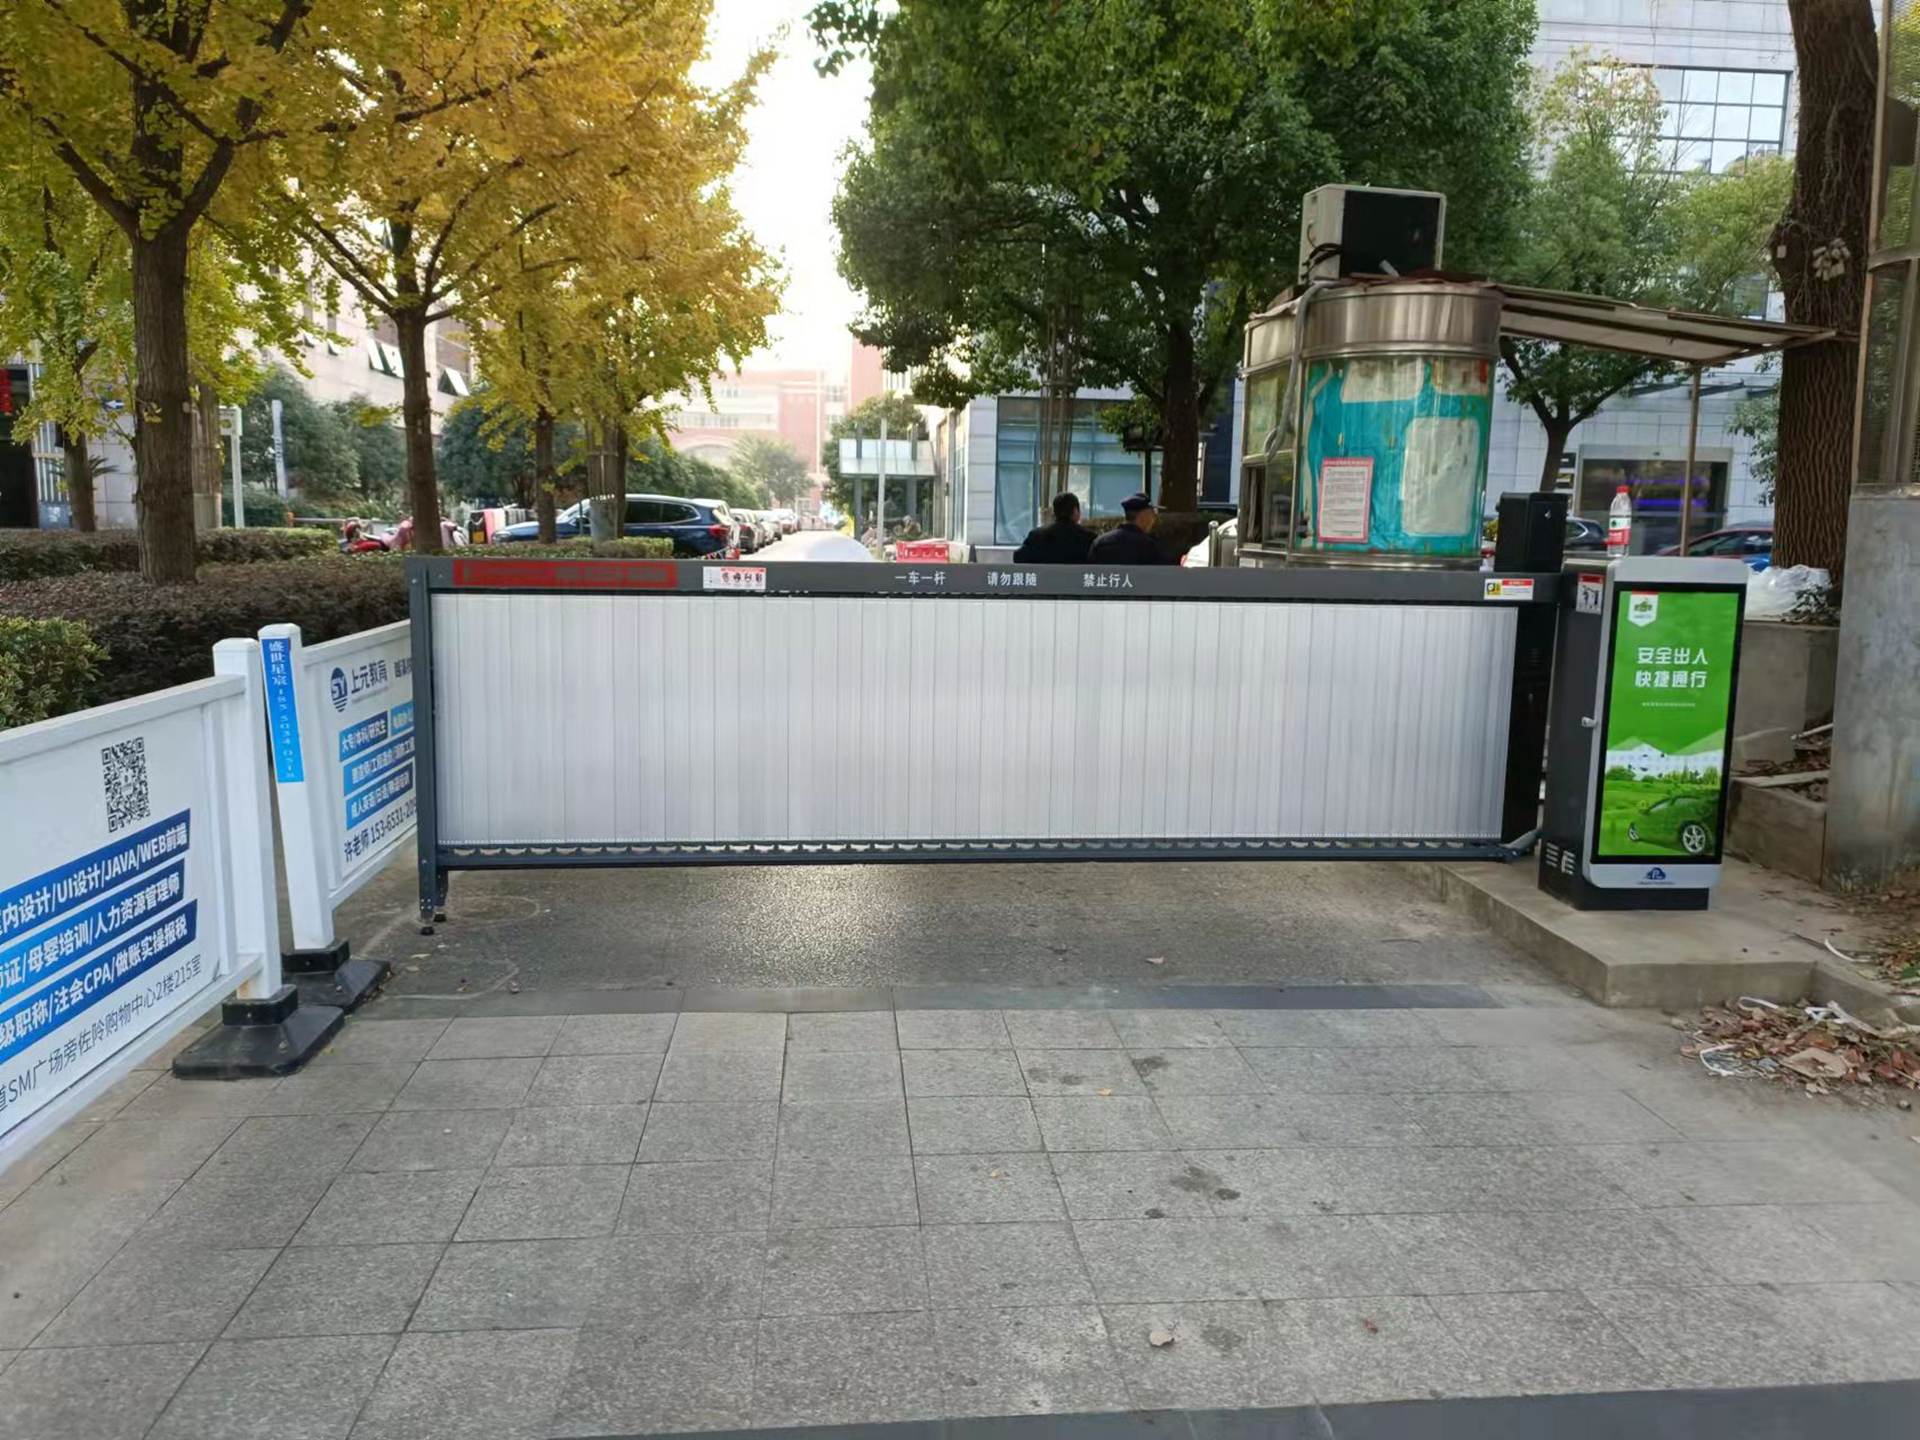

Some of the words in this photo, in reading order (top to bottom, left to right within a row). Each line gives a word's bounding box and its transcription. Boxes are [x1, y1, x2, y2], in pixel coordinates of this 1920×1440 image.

[894, 571, 946, 586] 一车一杆
[986, 572, 1037, 587] 请勿跟随
[1082, 573, 1133, 588] 禁止行人
[351, 660, 388, 695] 上元教育
[1635, 671, 1708, 688] 快捷通行
[0, 822, 188, 936] 内设计/UI设计/JAVA/WEB前端
[0, 872, 180, 993] 证/母婴培训/人力资源管理师
